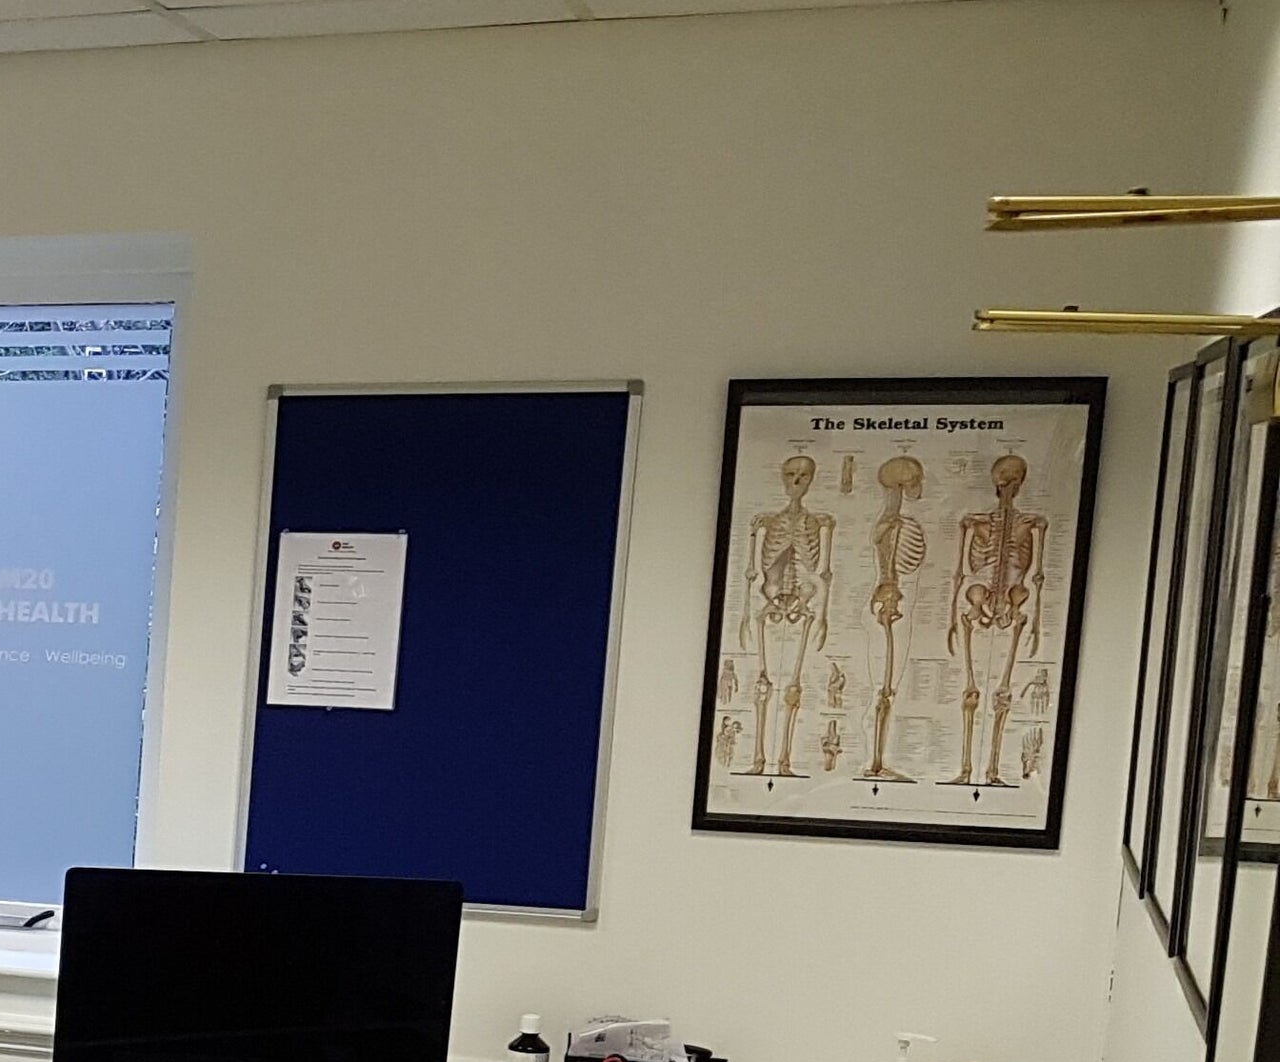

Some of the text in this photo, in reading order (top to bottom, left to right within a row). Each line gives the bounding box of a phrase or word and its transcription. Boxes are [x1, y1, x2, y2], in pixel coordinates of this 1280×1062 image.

[811, 418, 1004, 433] The Skeletal System
[45, 650, 127, 669] Wellbeing
